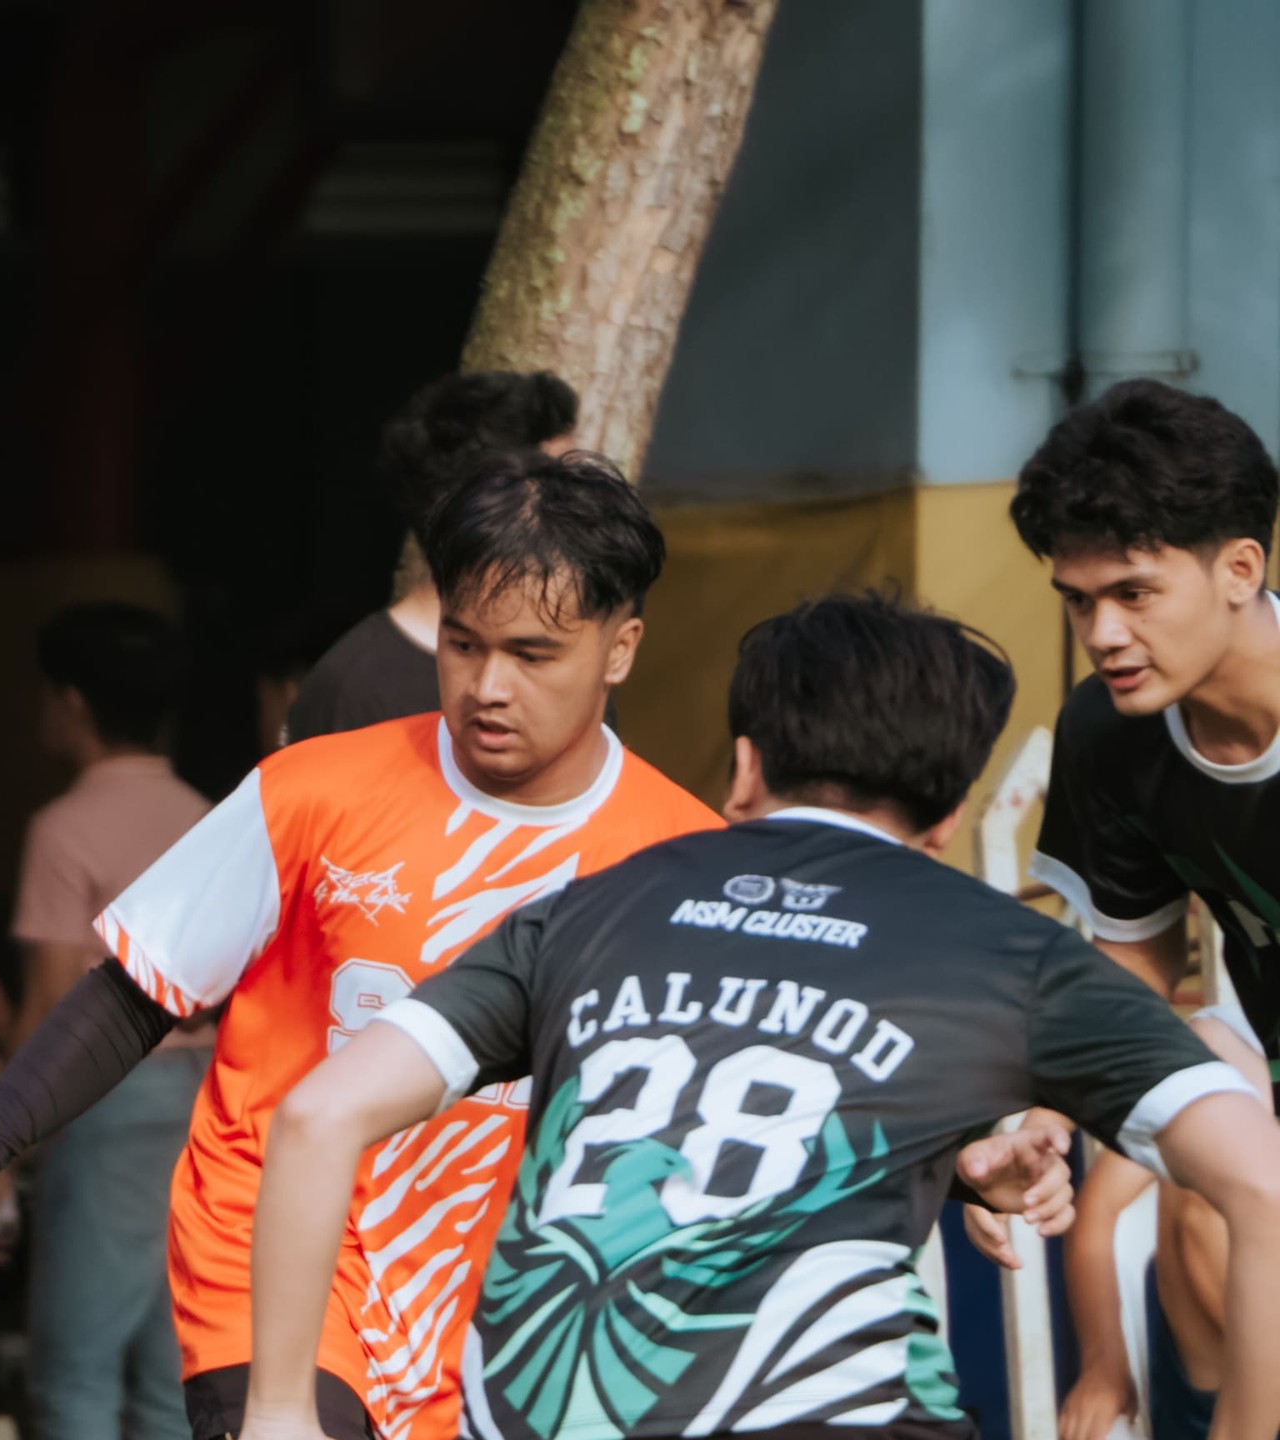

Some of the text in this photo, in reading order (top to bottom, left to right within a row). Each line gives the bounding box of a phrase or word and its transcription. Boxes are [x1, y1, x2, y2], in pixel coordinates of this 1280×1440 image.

[669, 899, 869, 949] NSM CLUSTER
[566, 971, 915, 1083] CALUNOD
[536, 1033, 843, 1228] 28
